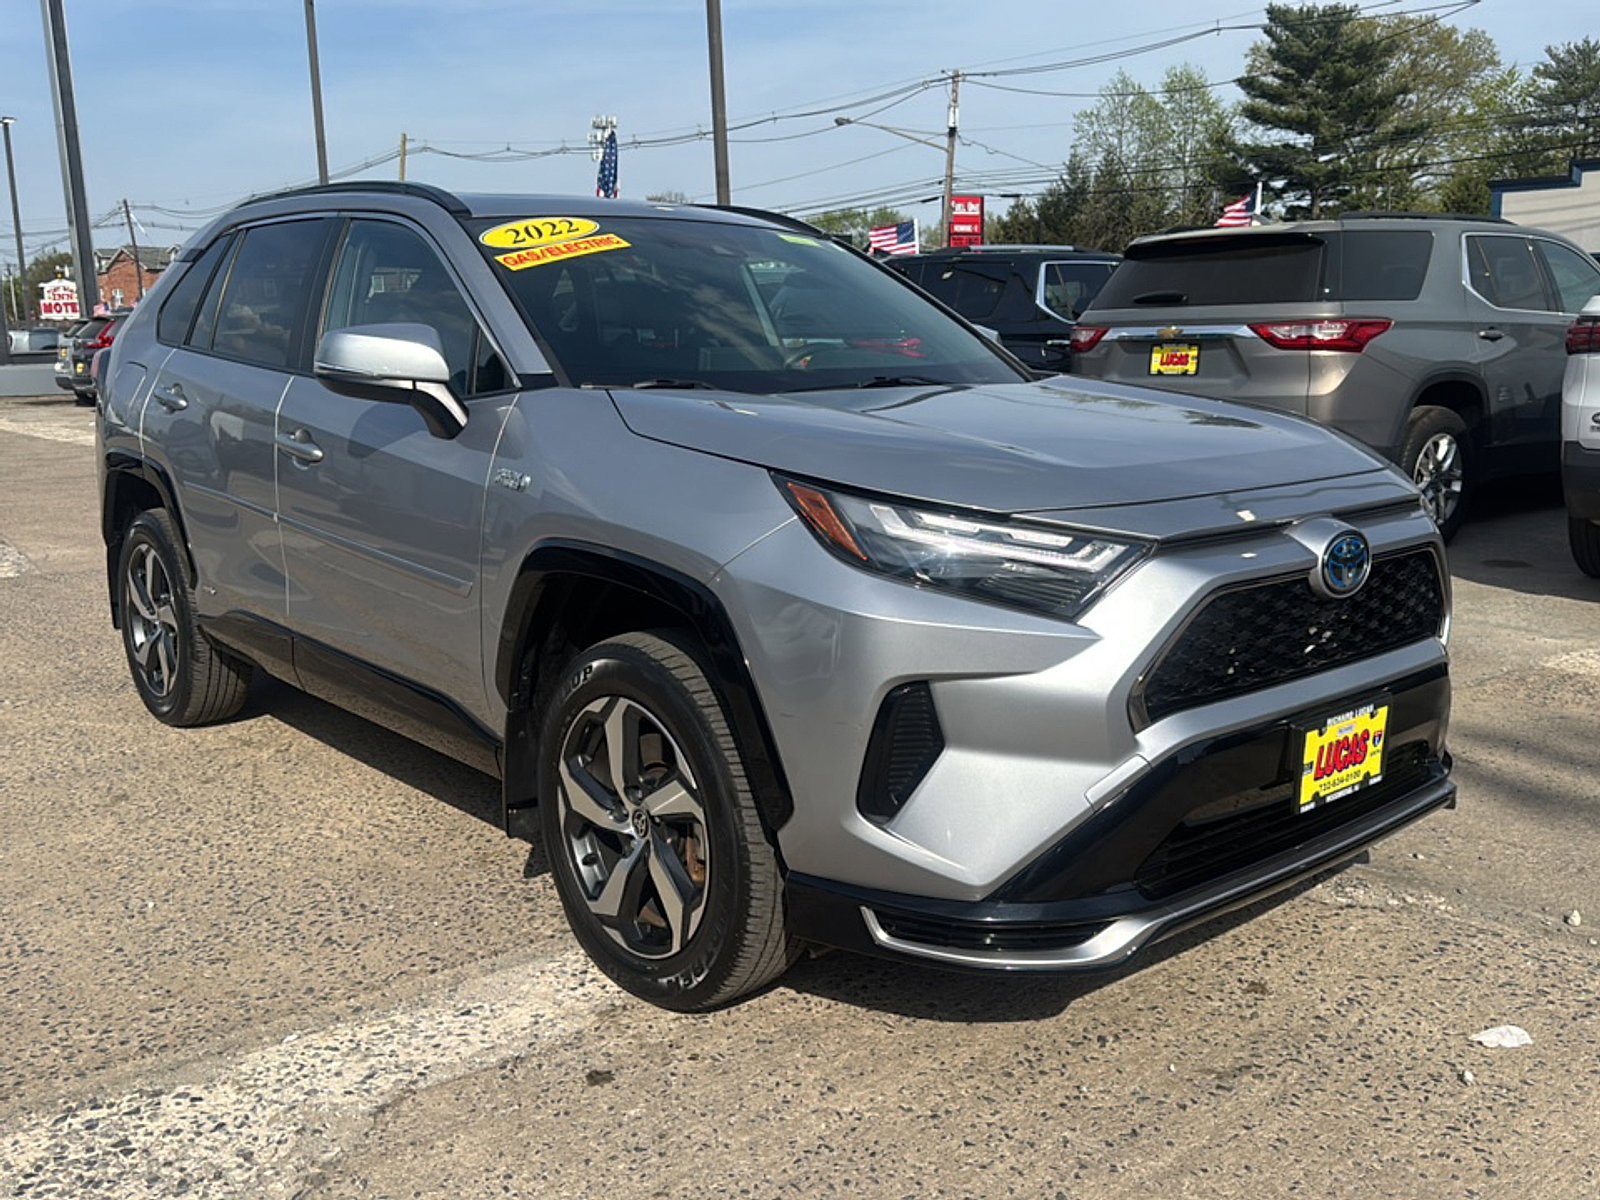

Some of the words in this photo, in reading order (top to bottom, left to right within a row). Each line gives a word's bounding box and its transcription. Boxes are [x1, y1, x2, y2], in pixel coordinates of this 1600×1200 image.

[505, 219, 580, 245] 2022
[503, 236, 622, 267] GAS/ELECTRIC
[43, 302, 79, 315] MOTE
[1160, 352, 1189, 366] LUCAS
[1314, 728, 1371, 781] LUCAS
